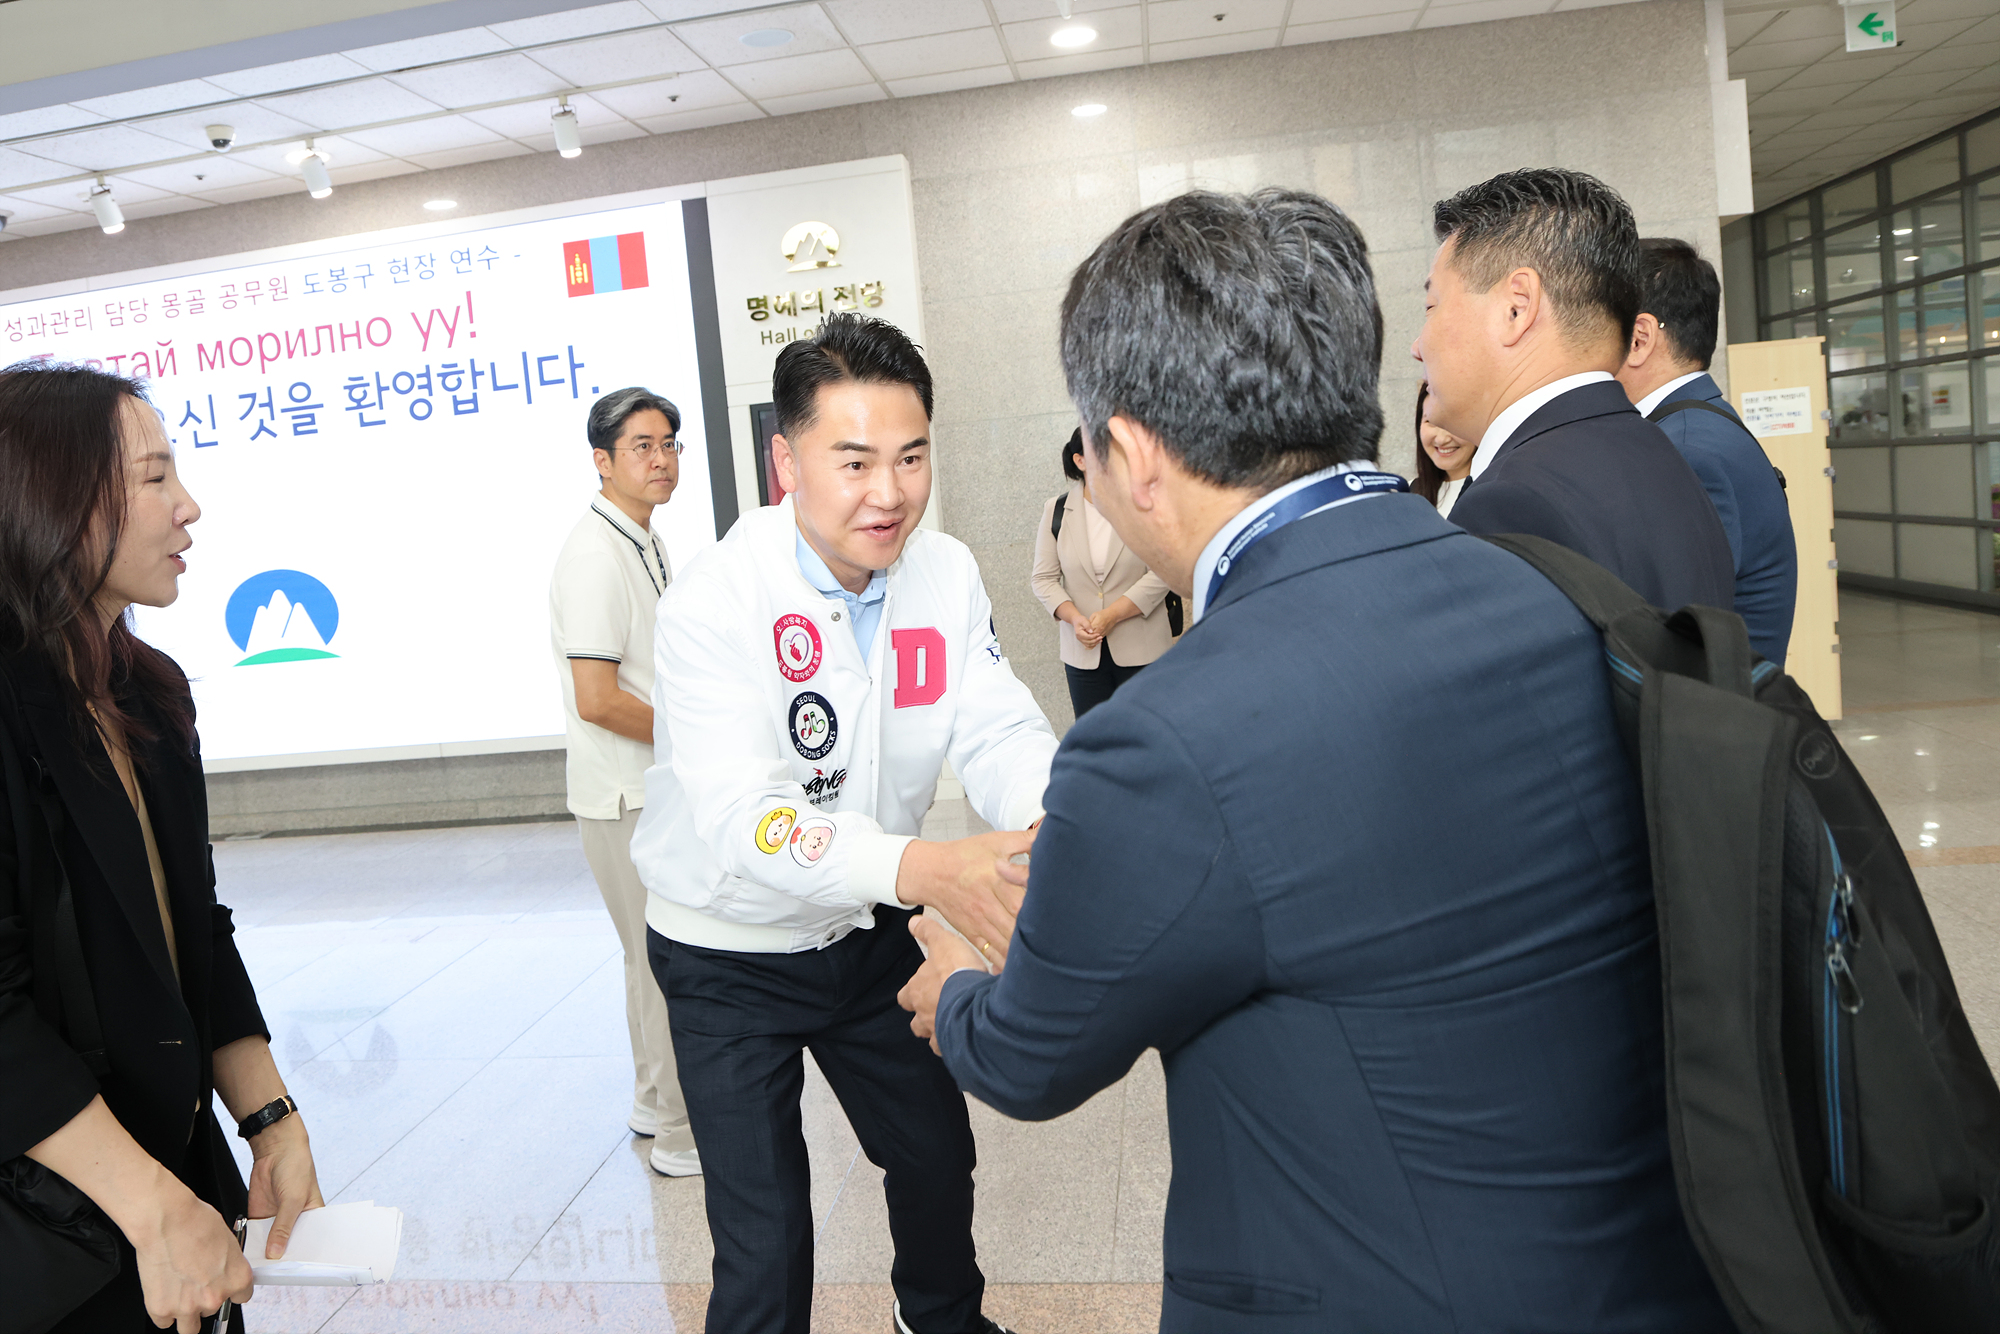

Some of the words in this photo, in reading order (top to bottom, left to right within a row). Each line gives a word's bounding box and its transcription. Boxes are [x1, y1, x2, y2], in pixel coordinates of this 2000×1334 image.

[4, 306, 93, 342] 성과관리
[105, 297, 149, 327] 담당
[161, 288, 206, 319] 몽골
[219, 275, 289, 310] 공무원
[303, 264, 375, 295] 도봉구
[387, 252, 437, 285] 현장
[450, 244, 501, 275] 연수
[747, 286, 824, 322] 명예의
[833, 280, 885, 311] 전당
[197, 316, 392, 375] морилно
[410, 290, 477, 352] уу!
[760, 326, 797, 346] Hall
[238, 381, 324, 441] 것을
[343, 344, 599, 428] 환영합니다.
[891, 626, 947, 709] D
[795, 694, 817, 708] SEOUL
[795, 741, 821, 759] DOBONG
[821, 730, 837, 755] SOCKS
